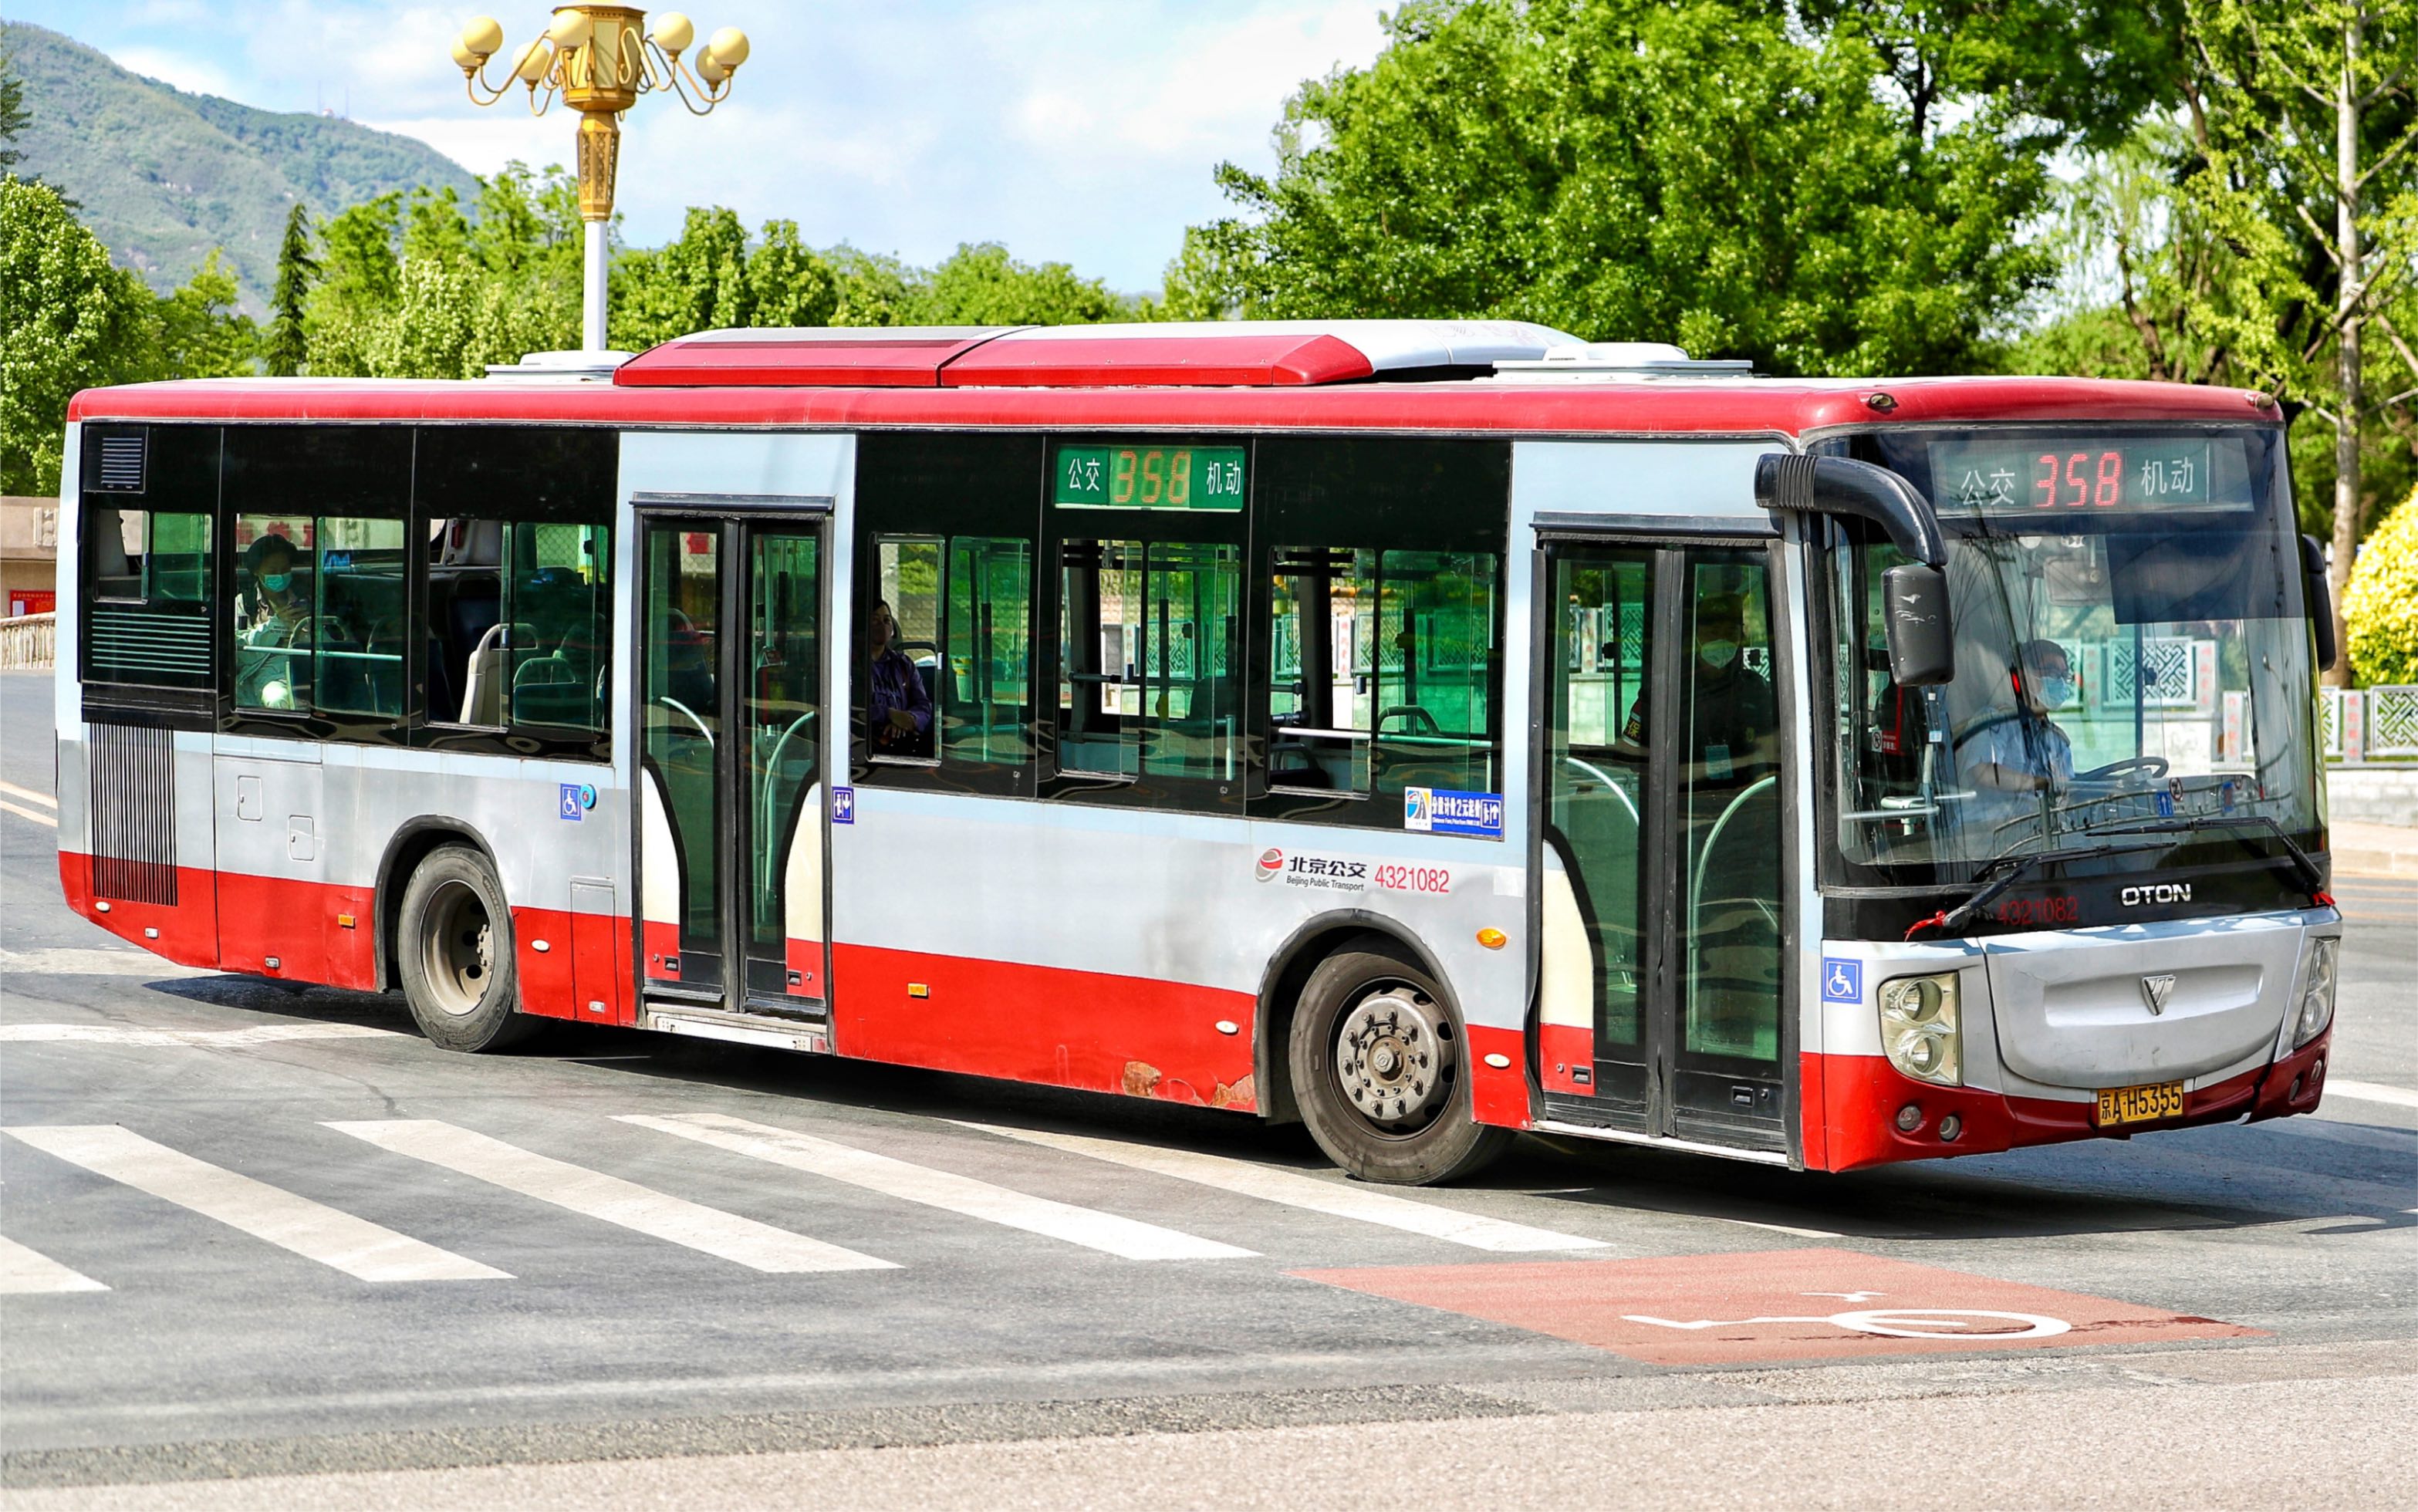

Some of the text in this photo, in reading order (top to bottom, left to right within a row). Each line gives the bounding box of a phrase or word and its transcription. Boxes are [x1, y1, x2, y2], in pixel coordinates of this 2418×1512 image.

[1068, 451, 1241, 504] 公交 358 机动
[1960, 452, 2194, 508] 公交 358 机动
[1288, 856, 1367, 879] 北京公交
[1374, 864, 1450, 893] 4321082
[1286, 875, 1365, 892] Beijing Public Transport
[2121, 883, 2192, 907] OTON
[1997, 895, 2079, 926] 4321082
